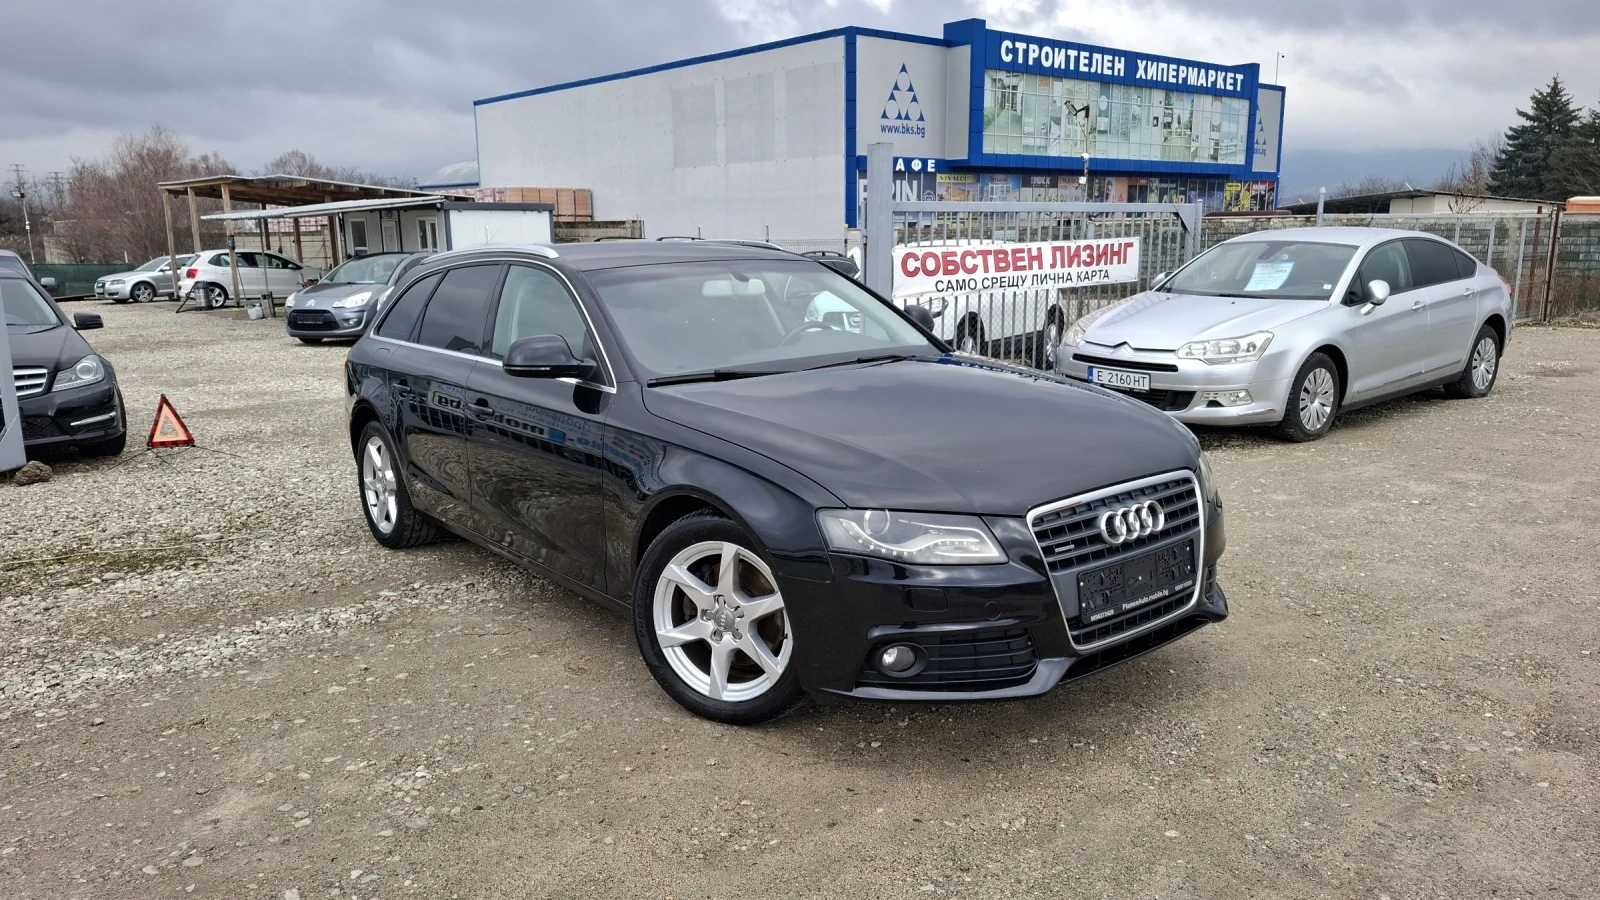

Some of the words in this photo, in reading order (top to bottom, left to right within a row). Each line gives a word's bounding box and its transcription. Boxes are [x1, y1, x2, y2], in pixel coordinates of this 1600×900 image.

[1000, 40, 1125, 77] СТРОИТЕЛЕН
[1135, 59, 1244, 92] ХИПЕРМАРКЕТ
[880, 123, 926, 139] www.bks.bg
[901, 247, 1044, 278] СОБСТВЕН
[1050, 242, 1134, 269] ЛИЗИНГ
[935, 278, 977, 293] САМО
[981, 274, 1027, 289] СРЕЩУ
[1031, 271, 1073, 286] ЛИЧНА
[1076, 269, 1110, 281] КАРТА
[1097, 370, 1104, 381] E
[1107, 372, 1131, 386] 2160
[1133, 376, 1147, 388] HT
